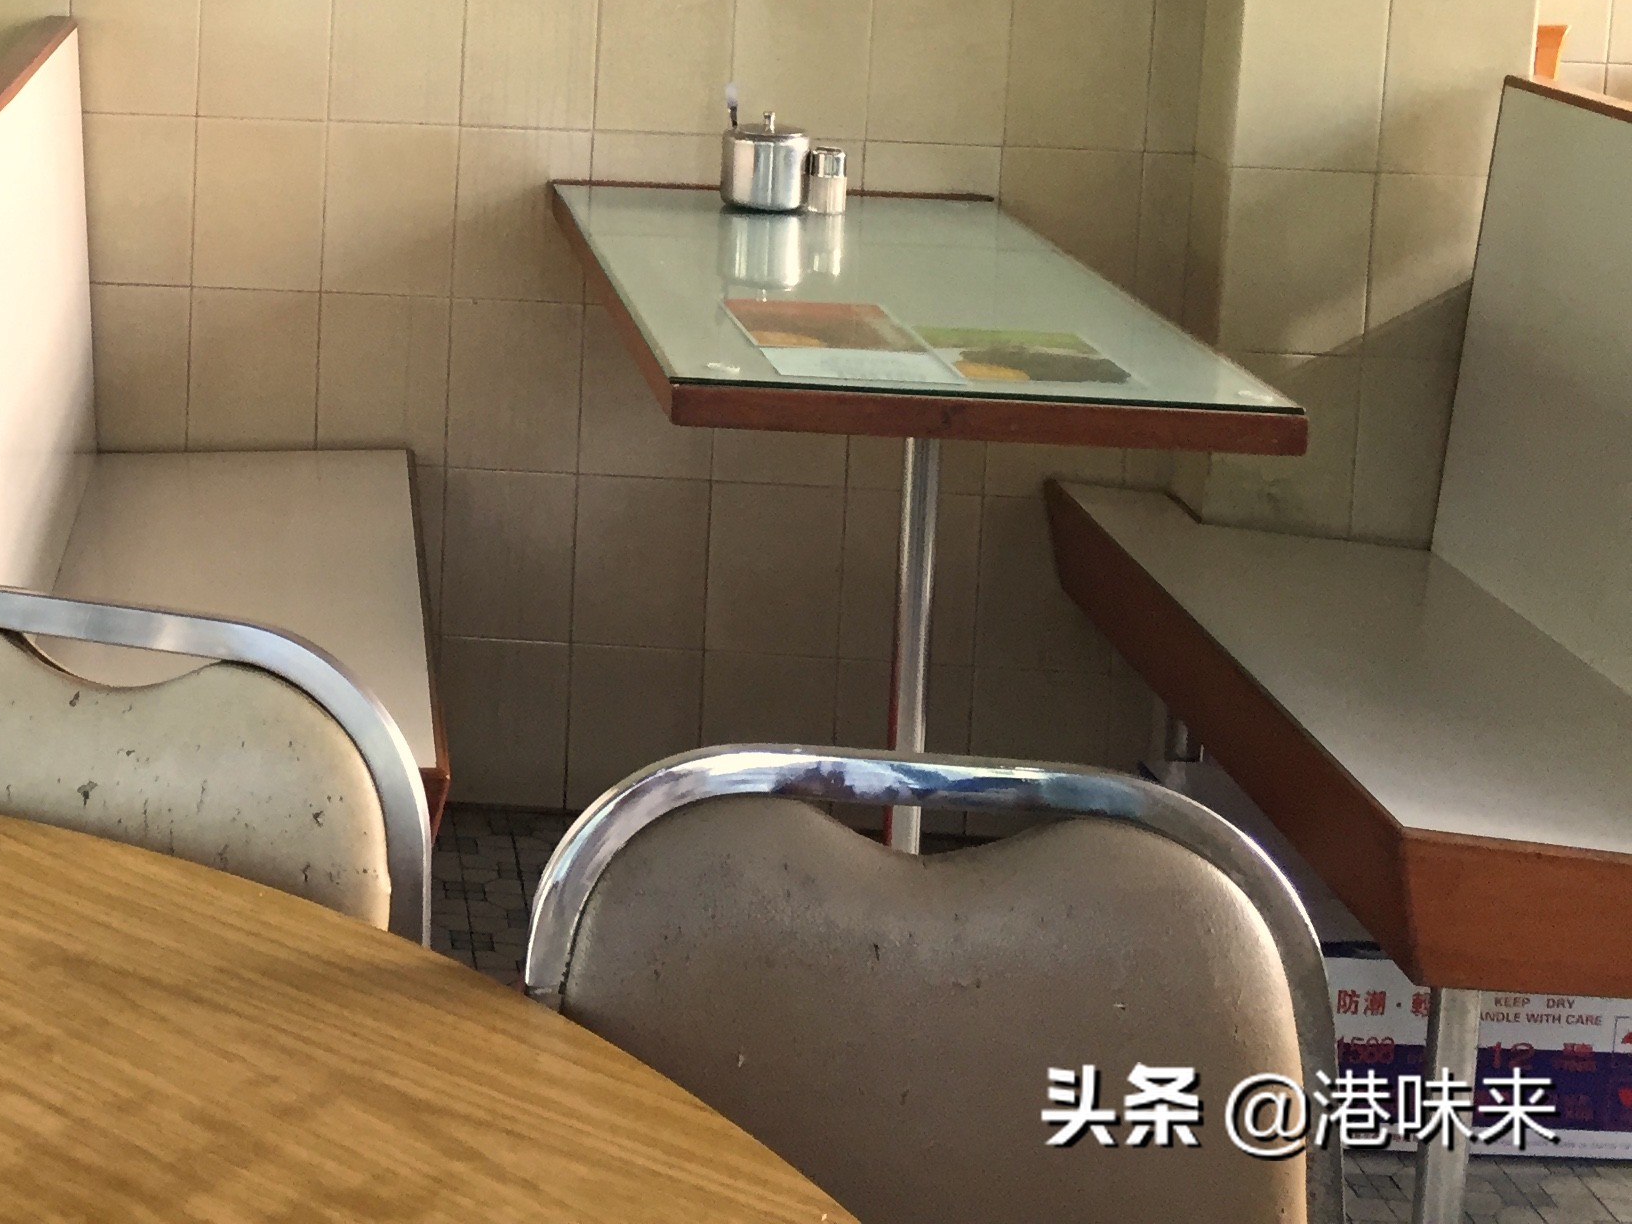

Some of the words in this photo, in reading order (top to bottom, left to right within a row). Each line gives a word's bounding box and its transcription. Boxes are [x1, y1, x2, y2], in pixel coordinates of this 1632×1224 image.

[1495, 997, 1531, 1008] KEEP
[1546, 998, 1576, 1009] DRY
[1526, 1013, 1561, 1025] WITH
[1565, 1014, 1603, 1026] CARE
